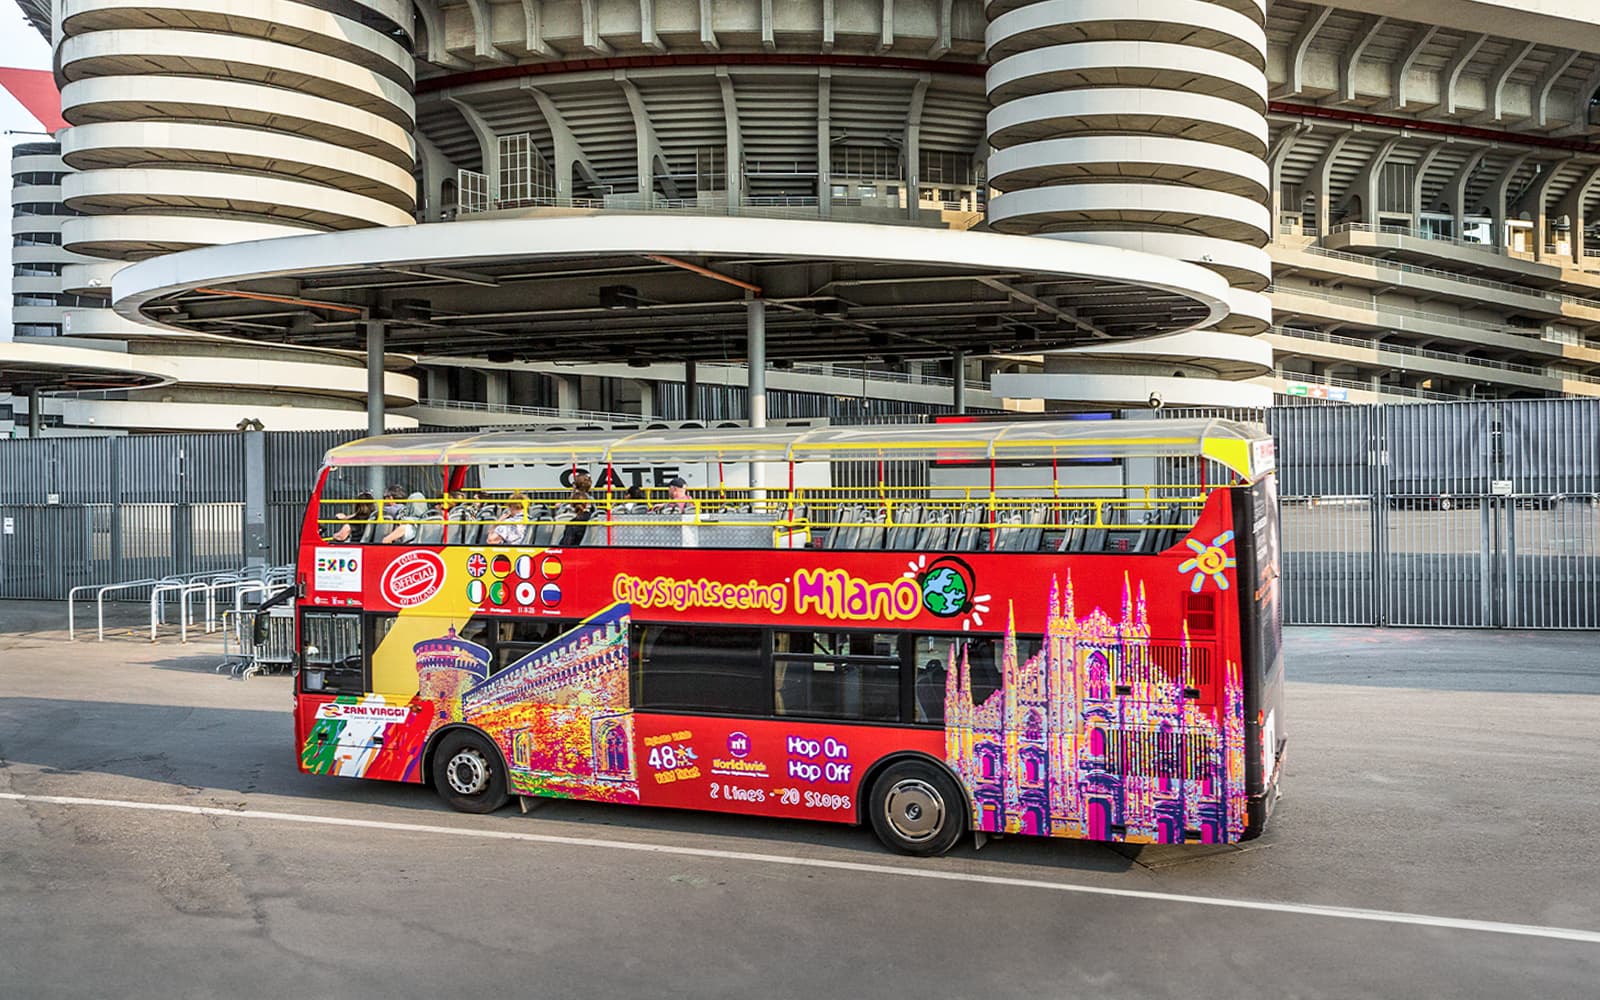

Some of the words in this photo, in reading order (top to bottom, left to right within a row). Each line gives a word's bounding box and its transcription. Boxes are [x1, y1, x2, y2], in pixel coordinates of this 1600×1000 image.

[559, 466, 679, 489] GATE
[317, 558, 358, 572] EXPO
[398, 553, 418, 566] TOUR
[392, 565, 435, 592] OFFICIAL
[410, 585, 437, 605] MILANO
[793, 567, 922, 621] Milano
[343, 706, 368, 715] ZANI
[369, 707, 405, 717] VIAGGI
[648, 745, 677, 770] 48
[787, 736, 821, 758] Hop
[824, 737, 848, 758] On
[788, 760, 822, 782] Hop
[825, 762, 852, 782] Off
[710, 782, 720, 799] 2
[723, 784, 766, 802] Lines
[780, 787, 800, 805] 20
[804, 790, 852, 810] Stops
